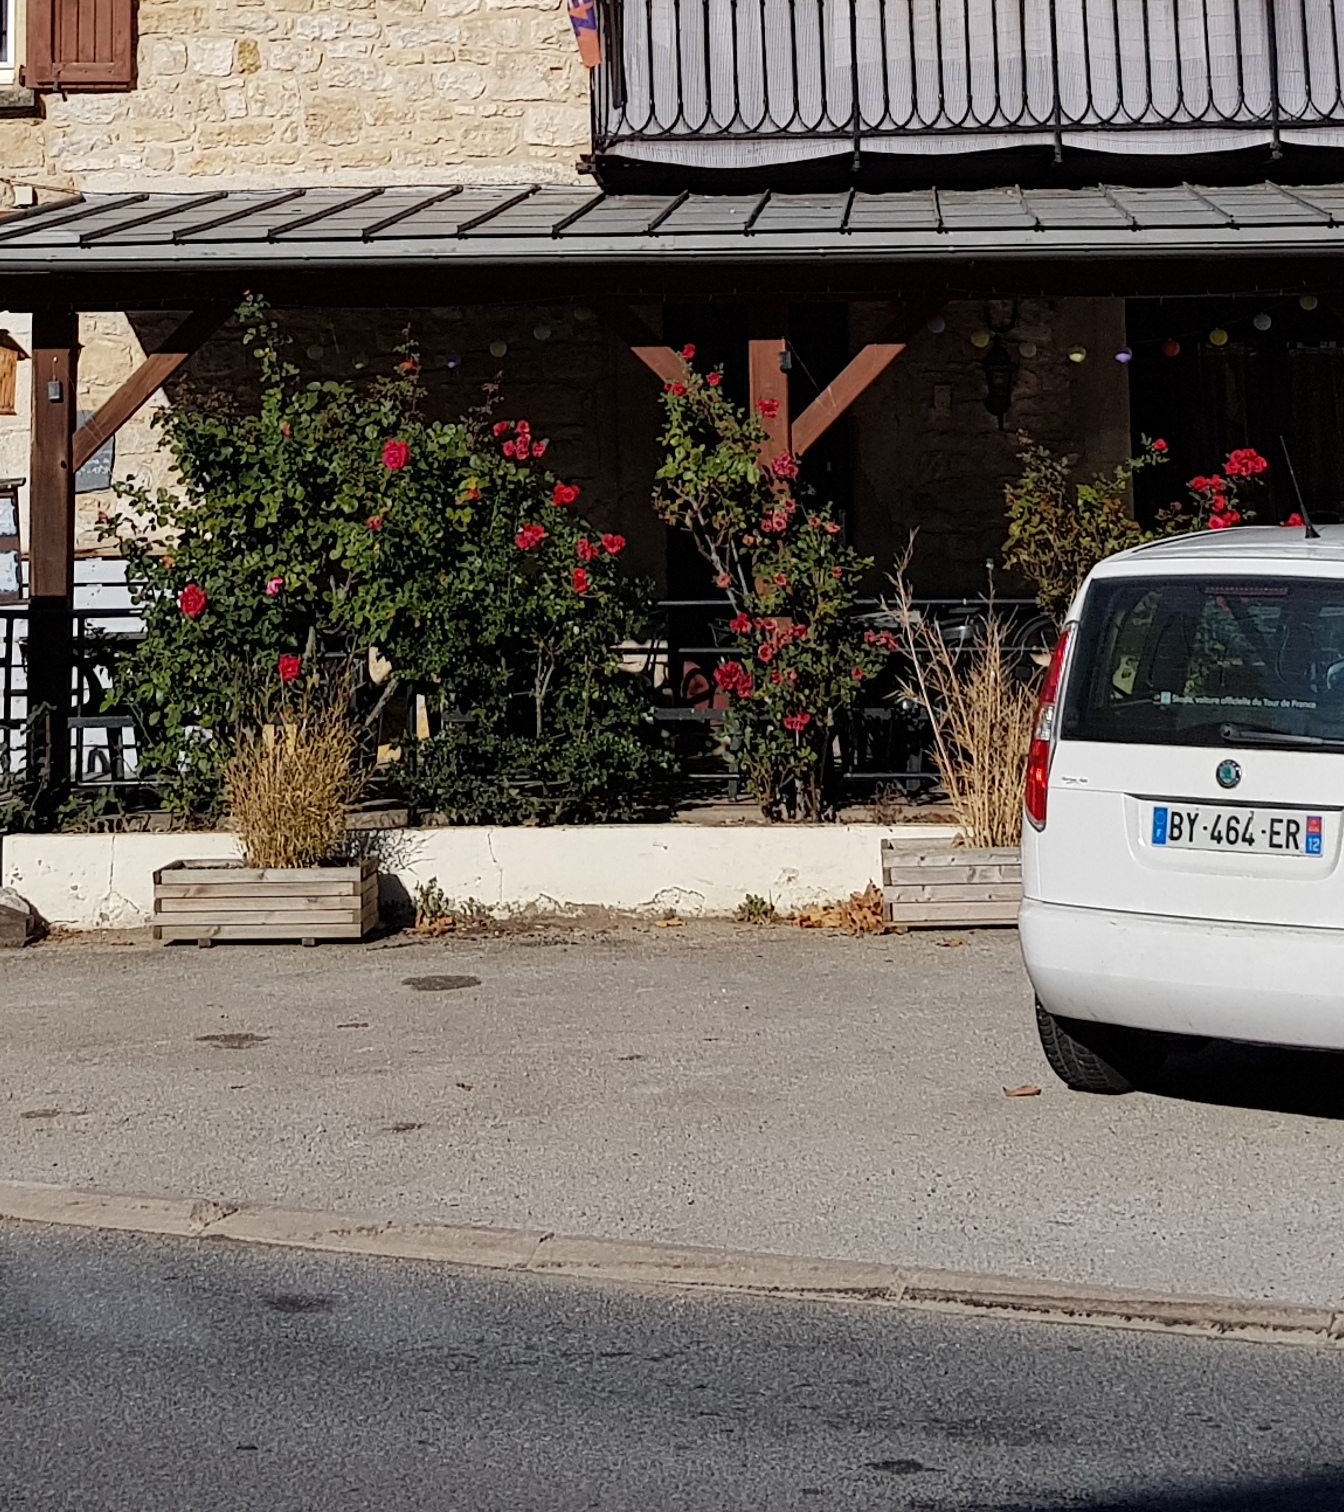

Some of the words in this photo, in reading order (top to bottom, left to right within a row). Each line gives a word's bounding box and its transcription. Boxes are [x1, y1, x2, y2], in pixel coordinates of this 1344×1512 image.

[1252, 697, 1262, 707] du
[1263, 697, 1279, 708] Tour
[1280, 698, 1290, 708] de
[1291, 699, 1317, 710] France
[1307, 838, 1320, 852] 12
